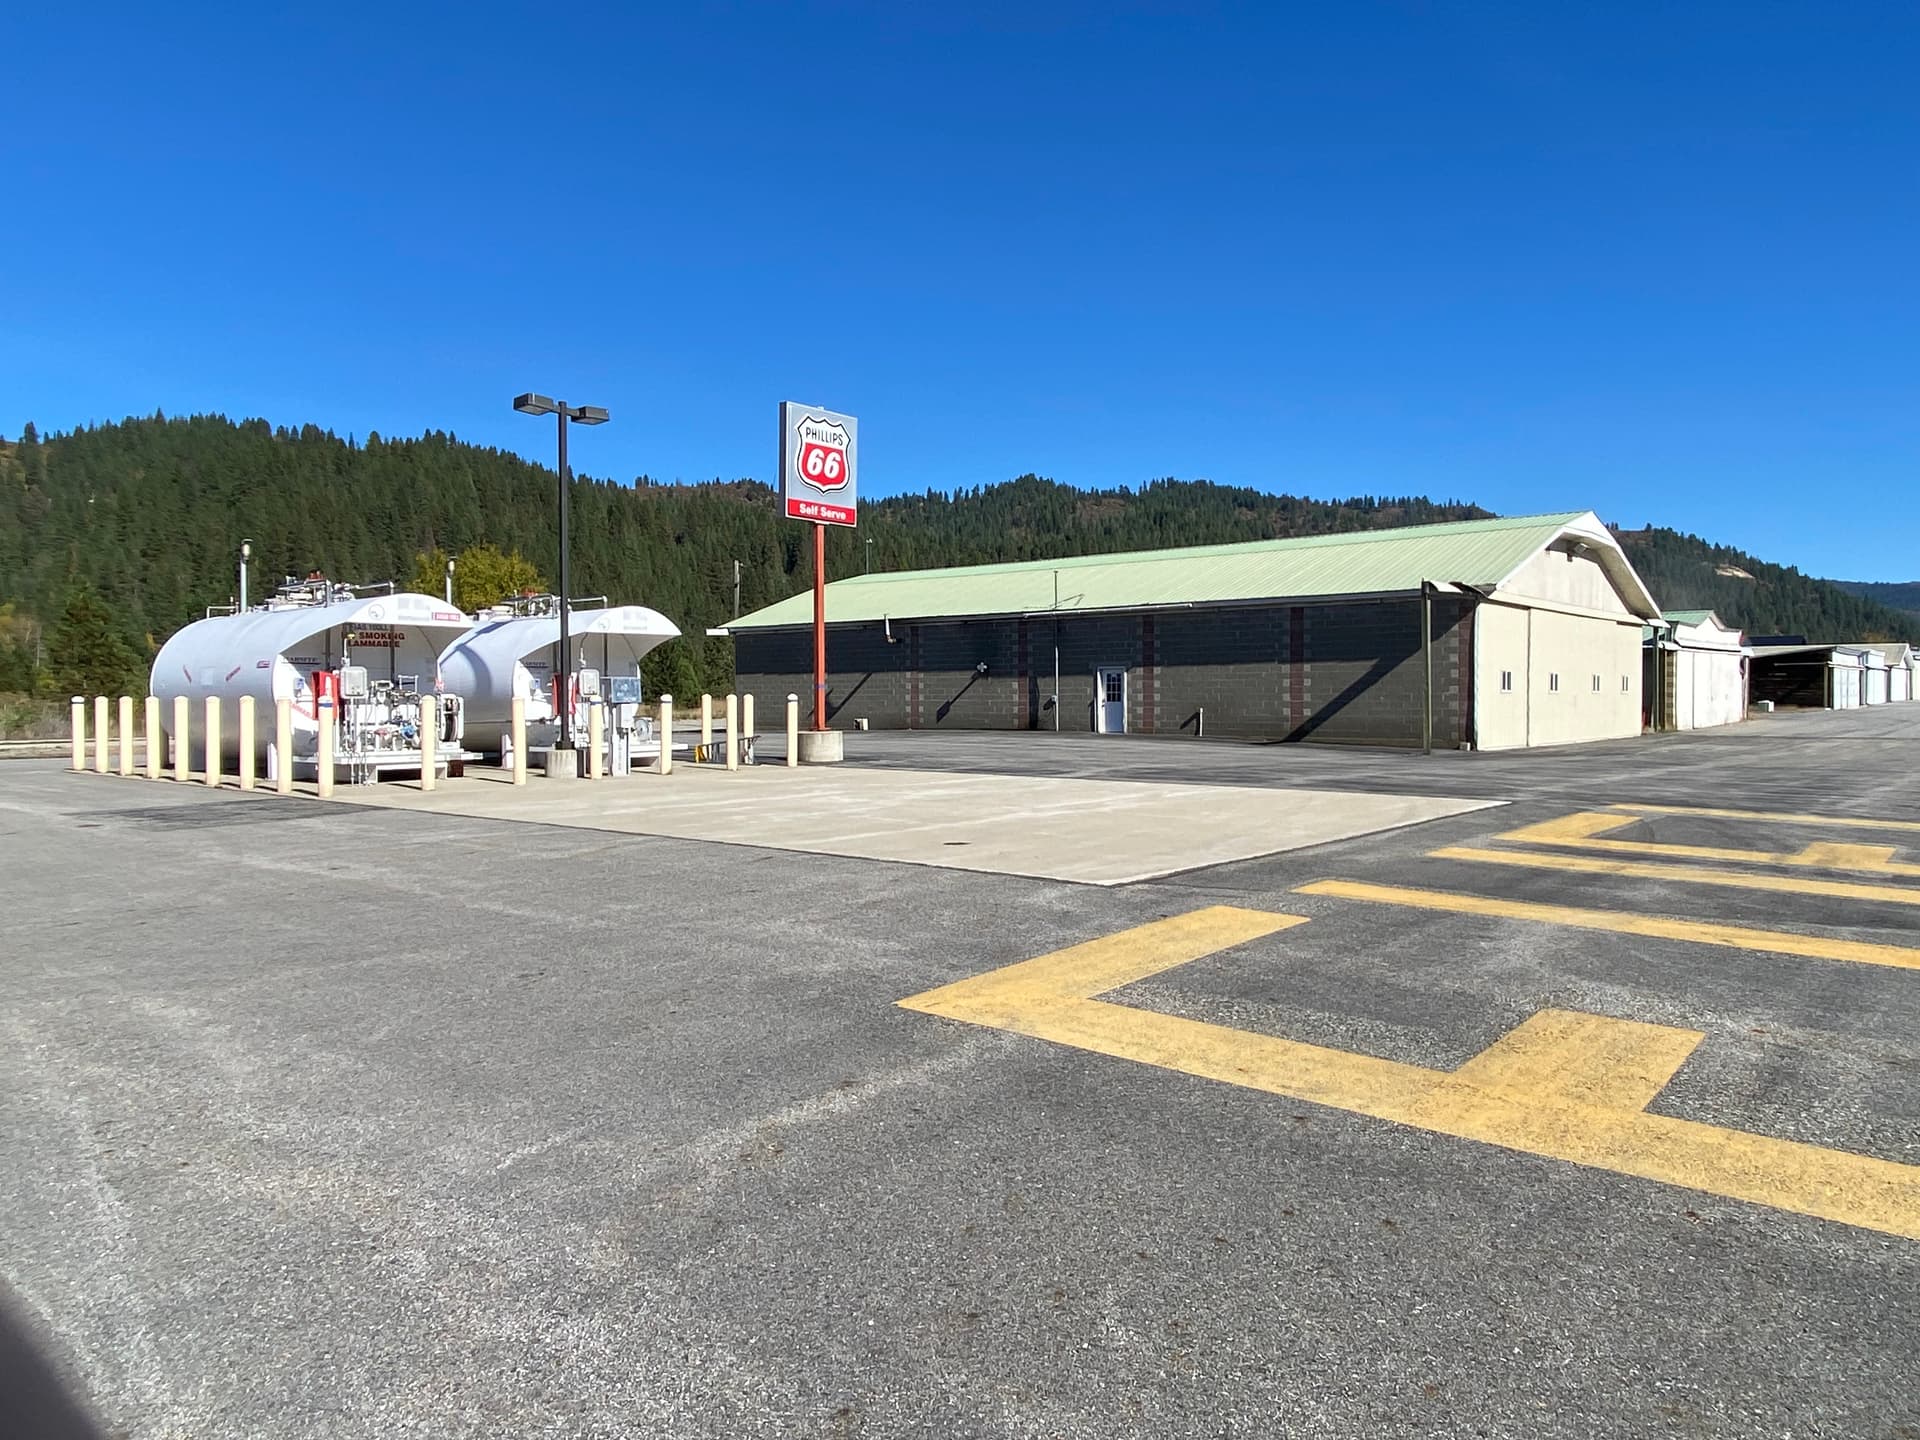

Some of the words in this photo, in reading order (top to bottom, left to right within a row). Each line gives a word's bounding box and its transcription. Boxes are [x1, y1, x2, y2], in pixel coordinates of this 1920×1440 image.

[805, 427, 844, 446] PHILLIPS
[806, 448, 842, 479] 66
[799, 503, 818, 515] Self
[820, 506, 847, 520] Serve
[347, 640, 401, 648] LAMMABLE
[359, 631, 405, 640] SMOKING
